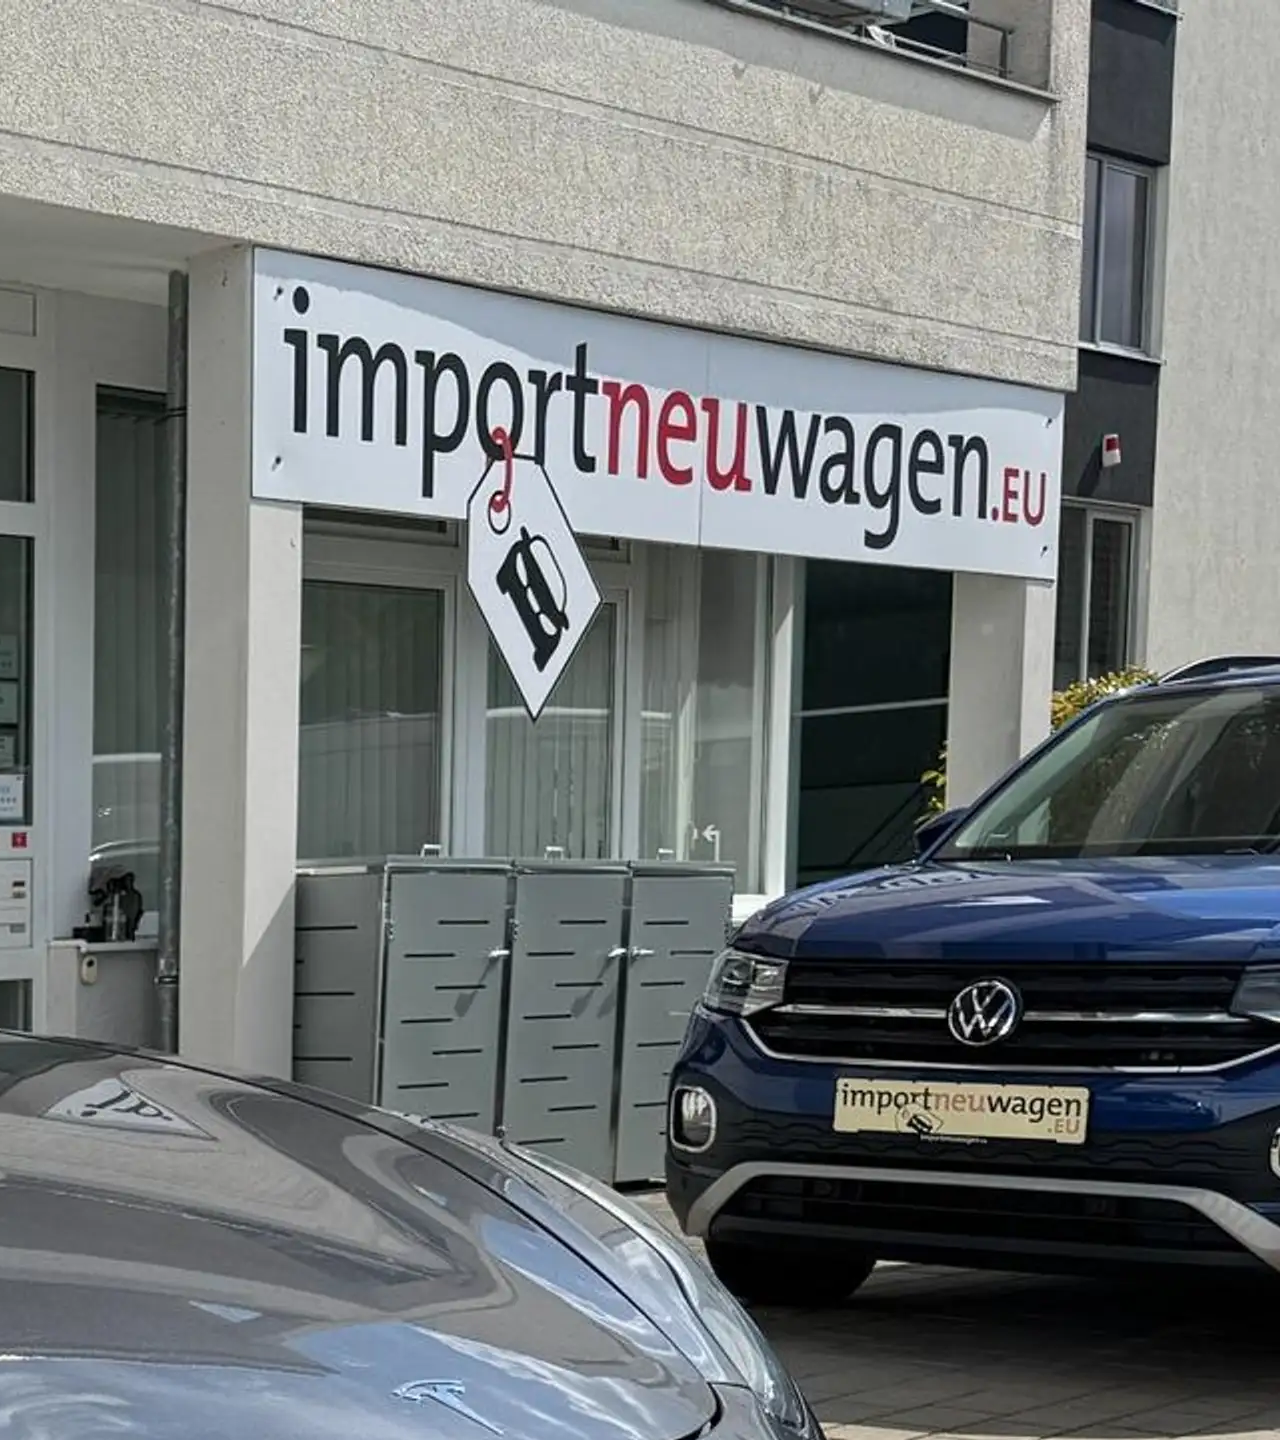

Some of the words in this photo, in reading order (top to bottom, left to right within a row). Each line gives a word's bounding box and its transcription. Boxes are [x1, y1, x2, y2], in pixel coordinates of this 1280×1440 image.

[284, 286, 1046, 550] importneuwagen.EU
[841, 1083, 1082, 1123] importneuwagen
[1046, 1118, 1081, 1135] .EU
